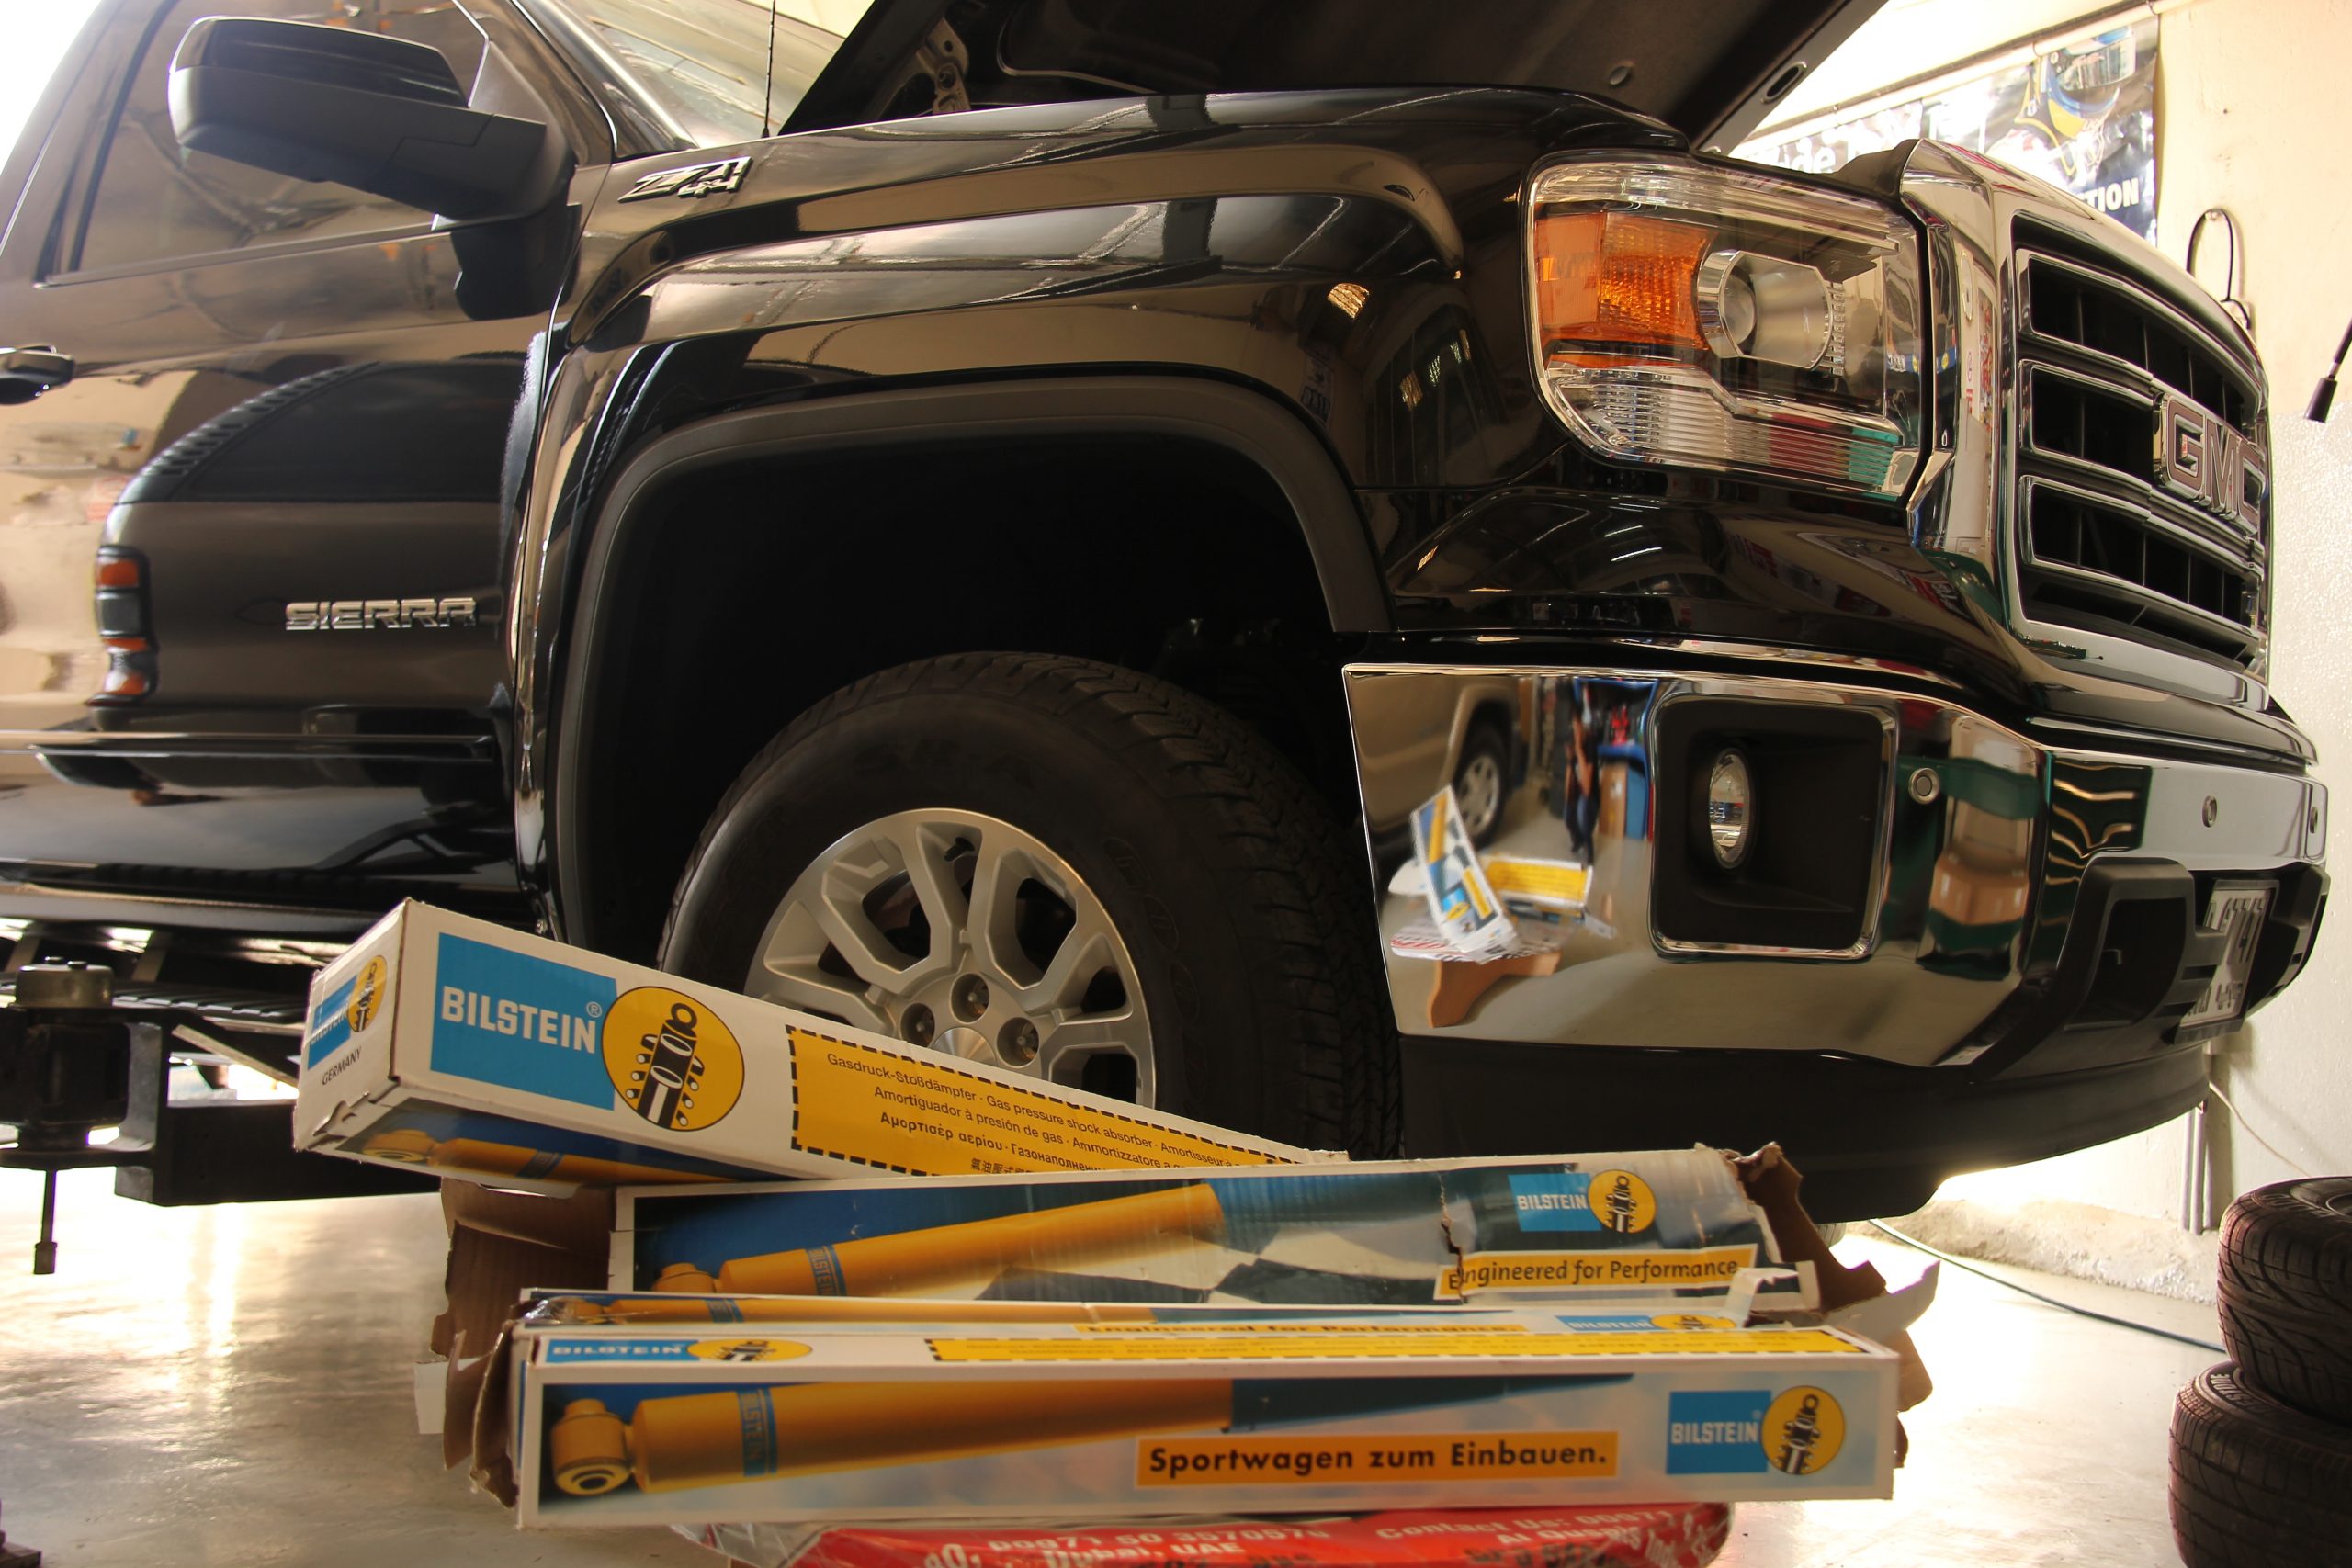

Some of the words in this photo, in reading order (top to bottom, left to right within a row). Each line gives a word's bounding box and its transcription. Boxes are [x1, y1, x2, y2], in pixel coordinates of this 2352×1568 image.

[2075, 177, 2139, 212] TION
[2161, 393, 2266, 535] GMC
[285, 597, 476, 631] SIERRA
[441, 985, 596, 1055] BILSTEIN
[322, 1045, 362, 1086] GERMANY
[827, 1053, 977, 1101] Gasdruck-Stoßdämpfer
[987, 1095, 1011, 1111] Gas
[1013, 1103, 1064, 1126] pressure
[1067, 1118, 1102, 1135] shock
[1103, 1125, 1152, 1148] absorber
[1160, 1142, 1227, 1168] Amortisseur
[874, 1086, 962, 1118] Amortiguador
[977, 1112, 1021, 1134] presión
[1023, 1124, 1039, 1137] de
[1042, 1132, 1064, 1145] gas
[1072, 1137, 1162, 1168] Ammortizzatore
[1518, 1193, 1589, 1212] BILSTEIN
[1449, 1259, 1567, 1291] Engineered
[1572, 1259, 1602, 1284] for
[1610, 1258, 1739, 1282] Performance
[553, 1346, 682, 1355] BILSTEIN
[1671, 1419, 1759, 1446] BILSTEIN
[1150, 1447, 1352, 1479] Sportwagen
[1369, 1450, 1435, 1468] zum
[1451, 1439, 1606, 1467] Einbauen.
[1378, 1521, 1510, 1540] Contact
[1513, 1517, 1570, 1531] Us:
[1170, 1542, 1246, 1554] UAE
